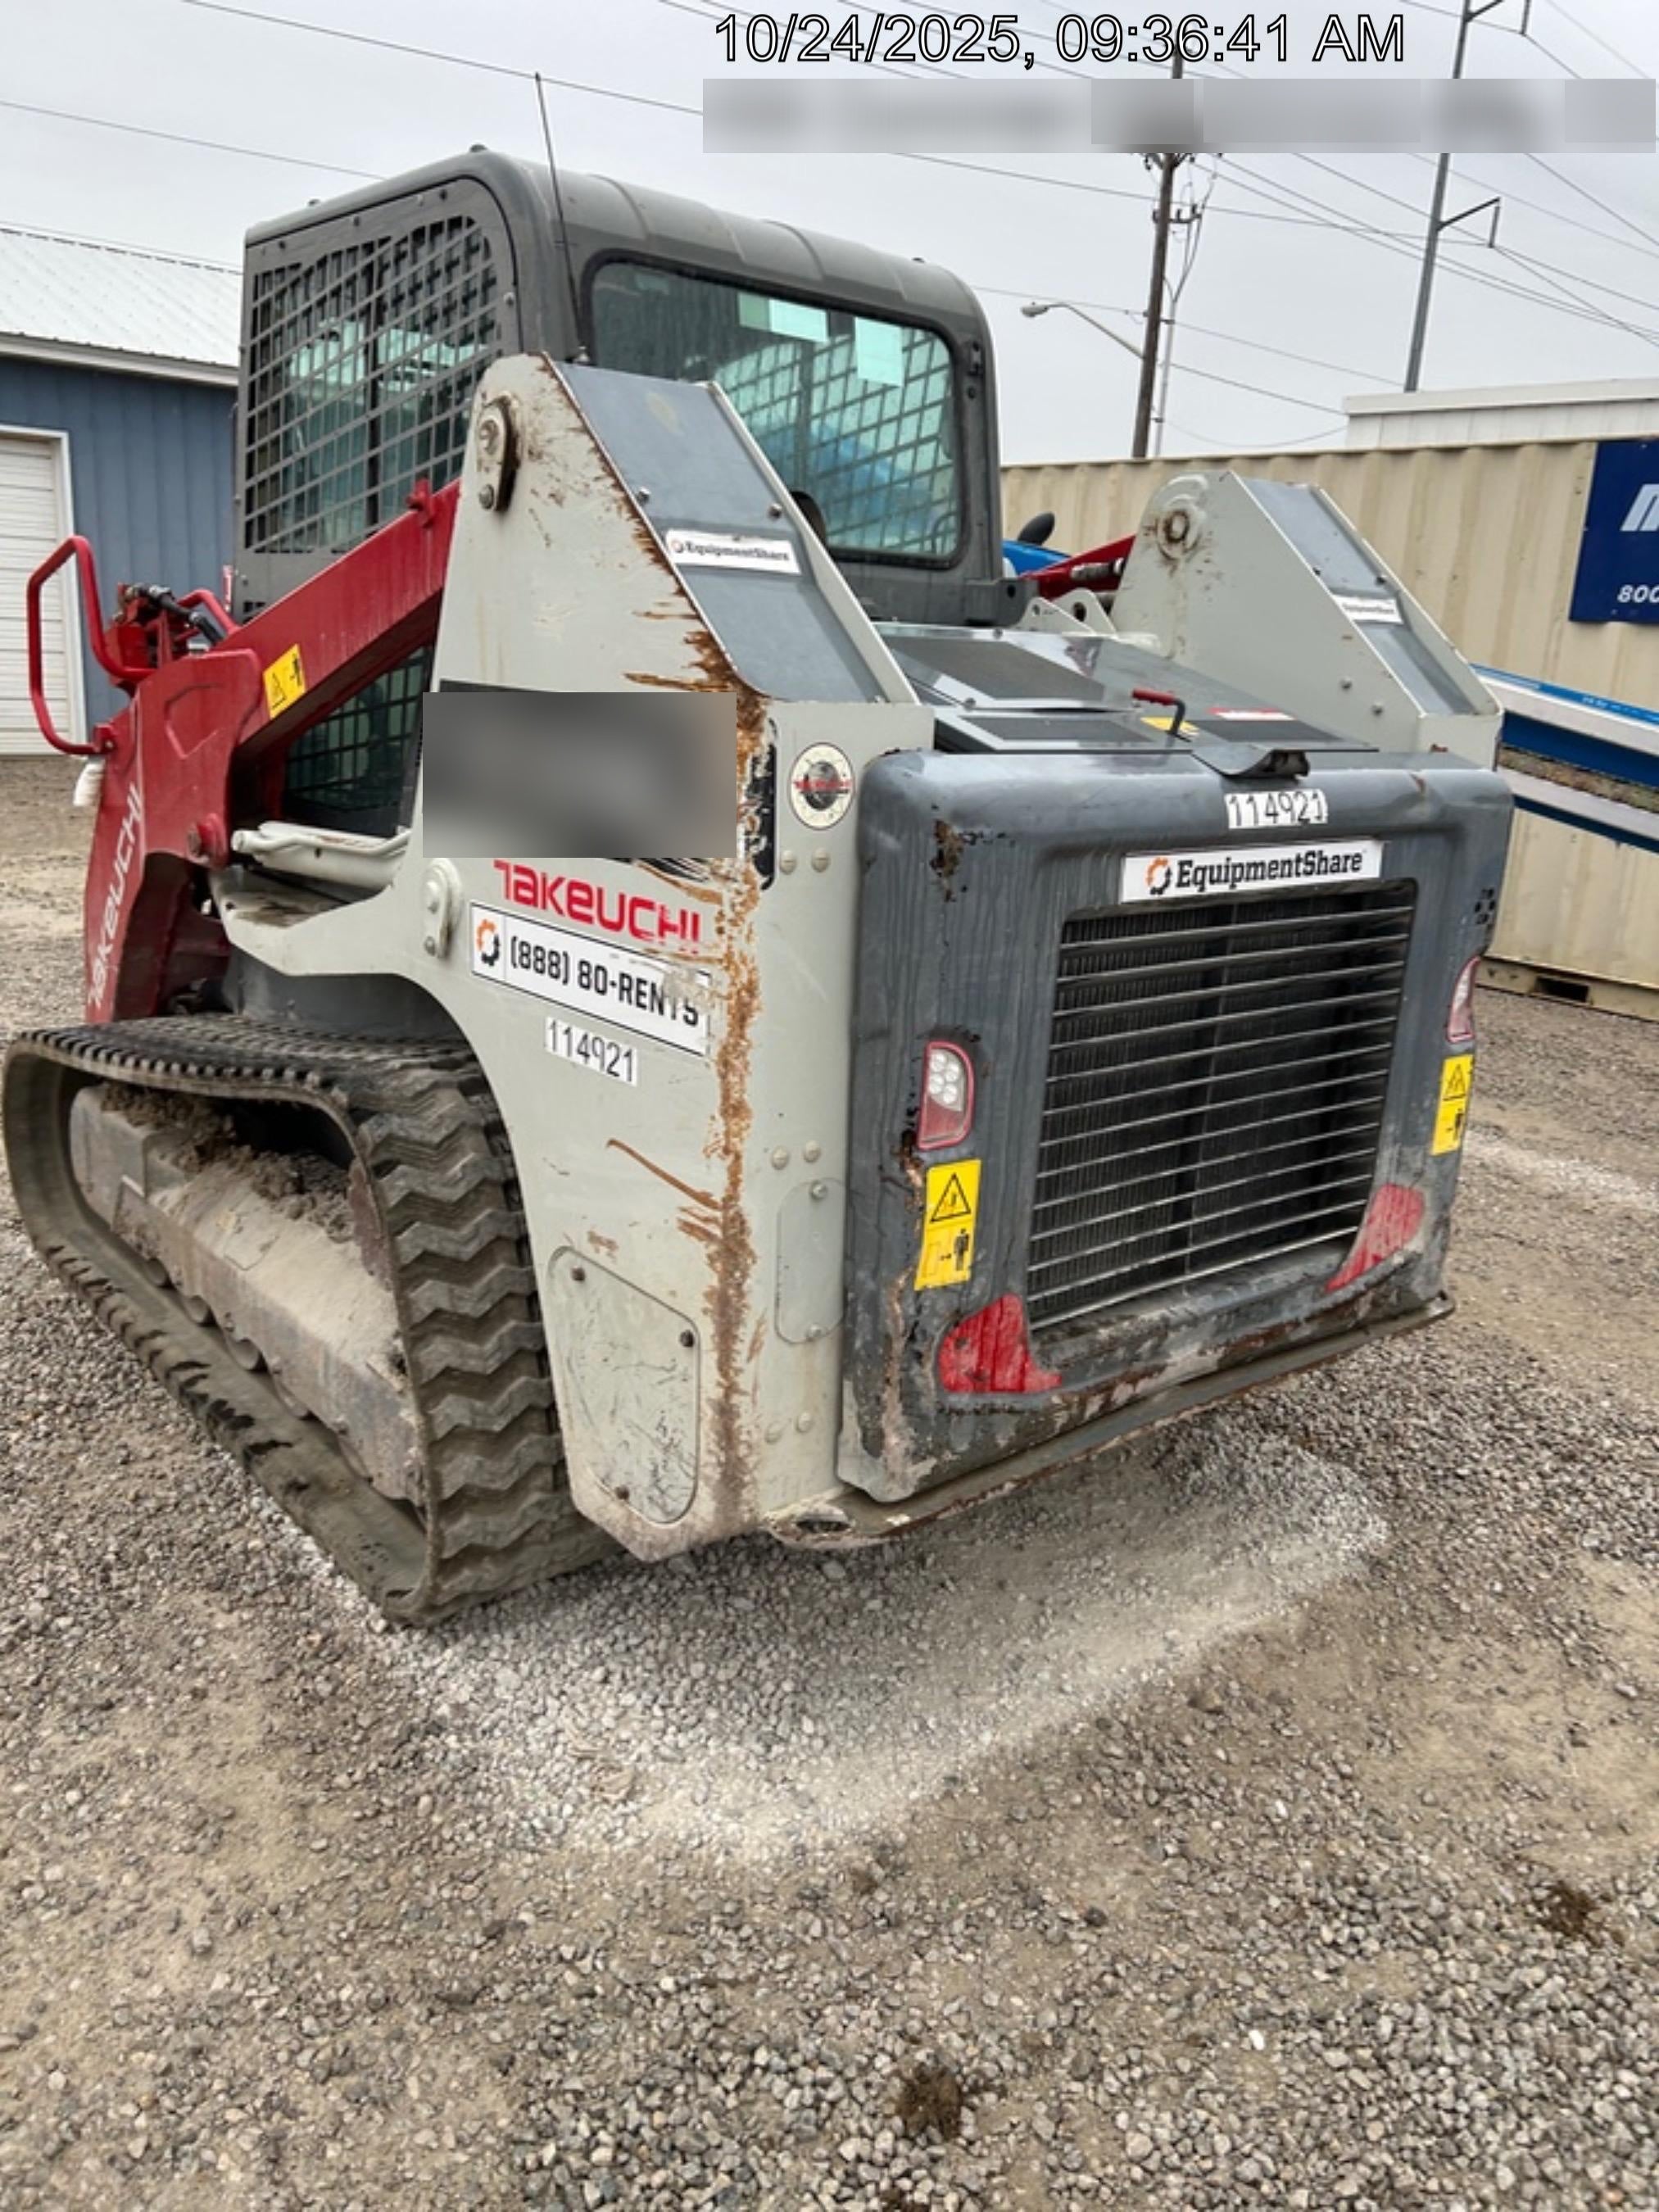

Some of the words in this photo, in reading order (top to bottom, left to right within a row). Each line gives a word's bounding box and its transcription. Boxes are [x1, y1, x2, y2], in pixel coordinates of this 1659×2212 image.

[1231, 791, 1324, 827] 114921
[1176, 850, 1363, 892] EquipmentShare
[510, 936, 570, 985] (888)
[547, 1019, 634, 1082] 114921
